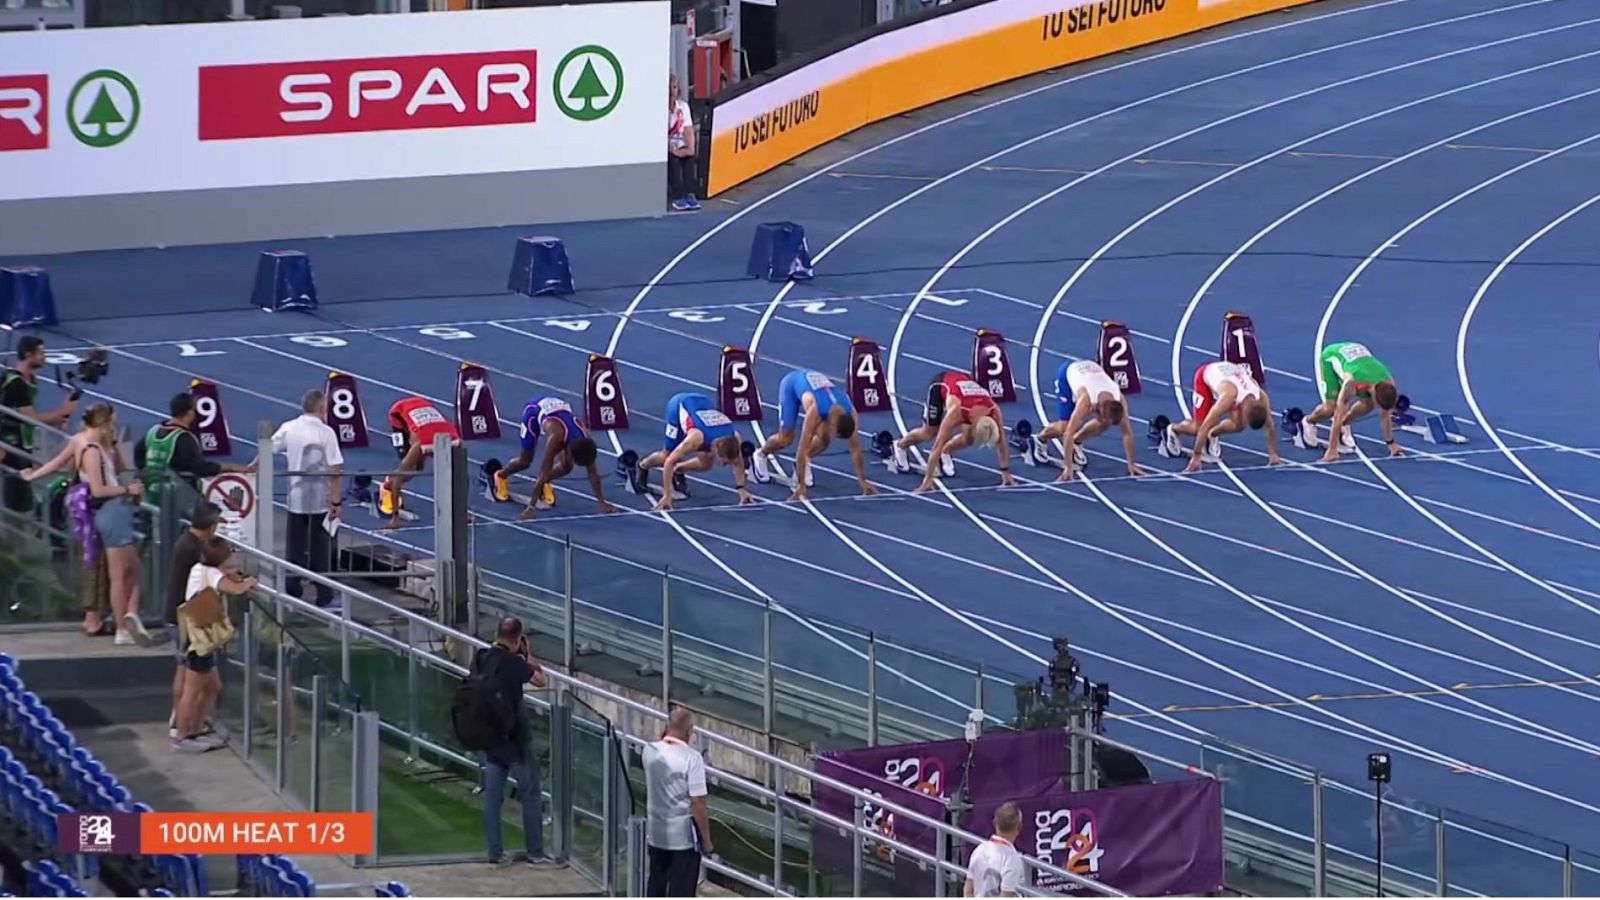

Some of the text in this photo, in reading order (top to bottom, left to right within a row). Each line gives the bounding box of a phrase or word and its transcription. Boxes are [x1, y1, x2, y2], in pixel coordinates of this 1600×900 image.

[1042, 12, 1063, 41] TU
[1067, 4, 1093, 34] SEI
[279, 63, 530, 122] SPAR
[734, 90, 819, 154] TU SEI FUTURO
[668, 310, 726, 323] 3
[786, 300, 848, 315] 2
[418, 326, 477, 340] 5
[543, 318, 591, 332] 4
[175, 343, 227, 357] 7
[289, 335, 347, 348] 6
[1107, 336, 1129, 367] 2
[1232, 328, 1246, 358] 1
[856, 353, 878, 384] 4
[985, 345, 1003, 376] 3
[595, 370, 615, 401] 6
[731, 362, 749, 393] 5
[332, 388, 355, 420] 8
[464, 378, 484, 411] 7
[196, 396, 217, 428] 9
